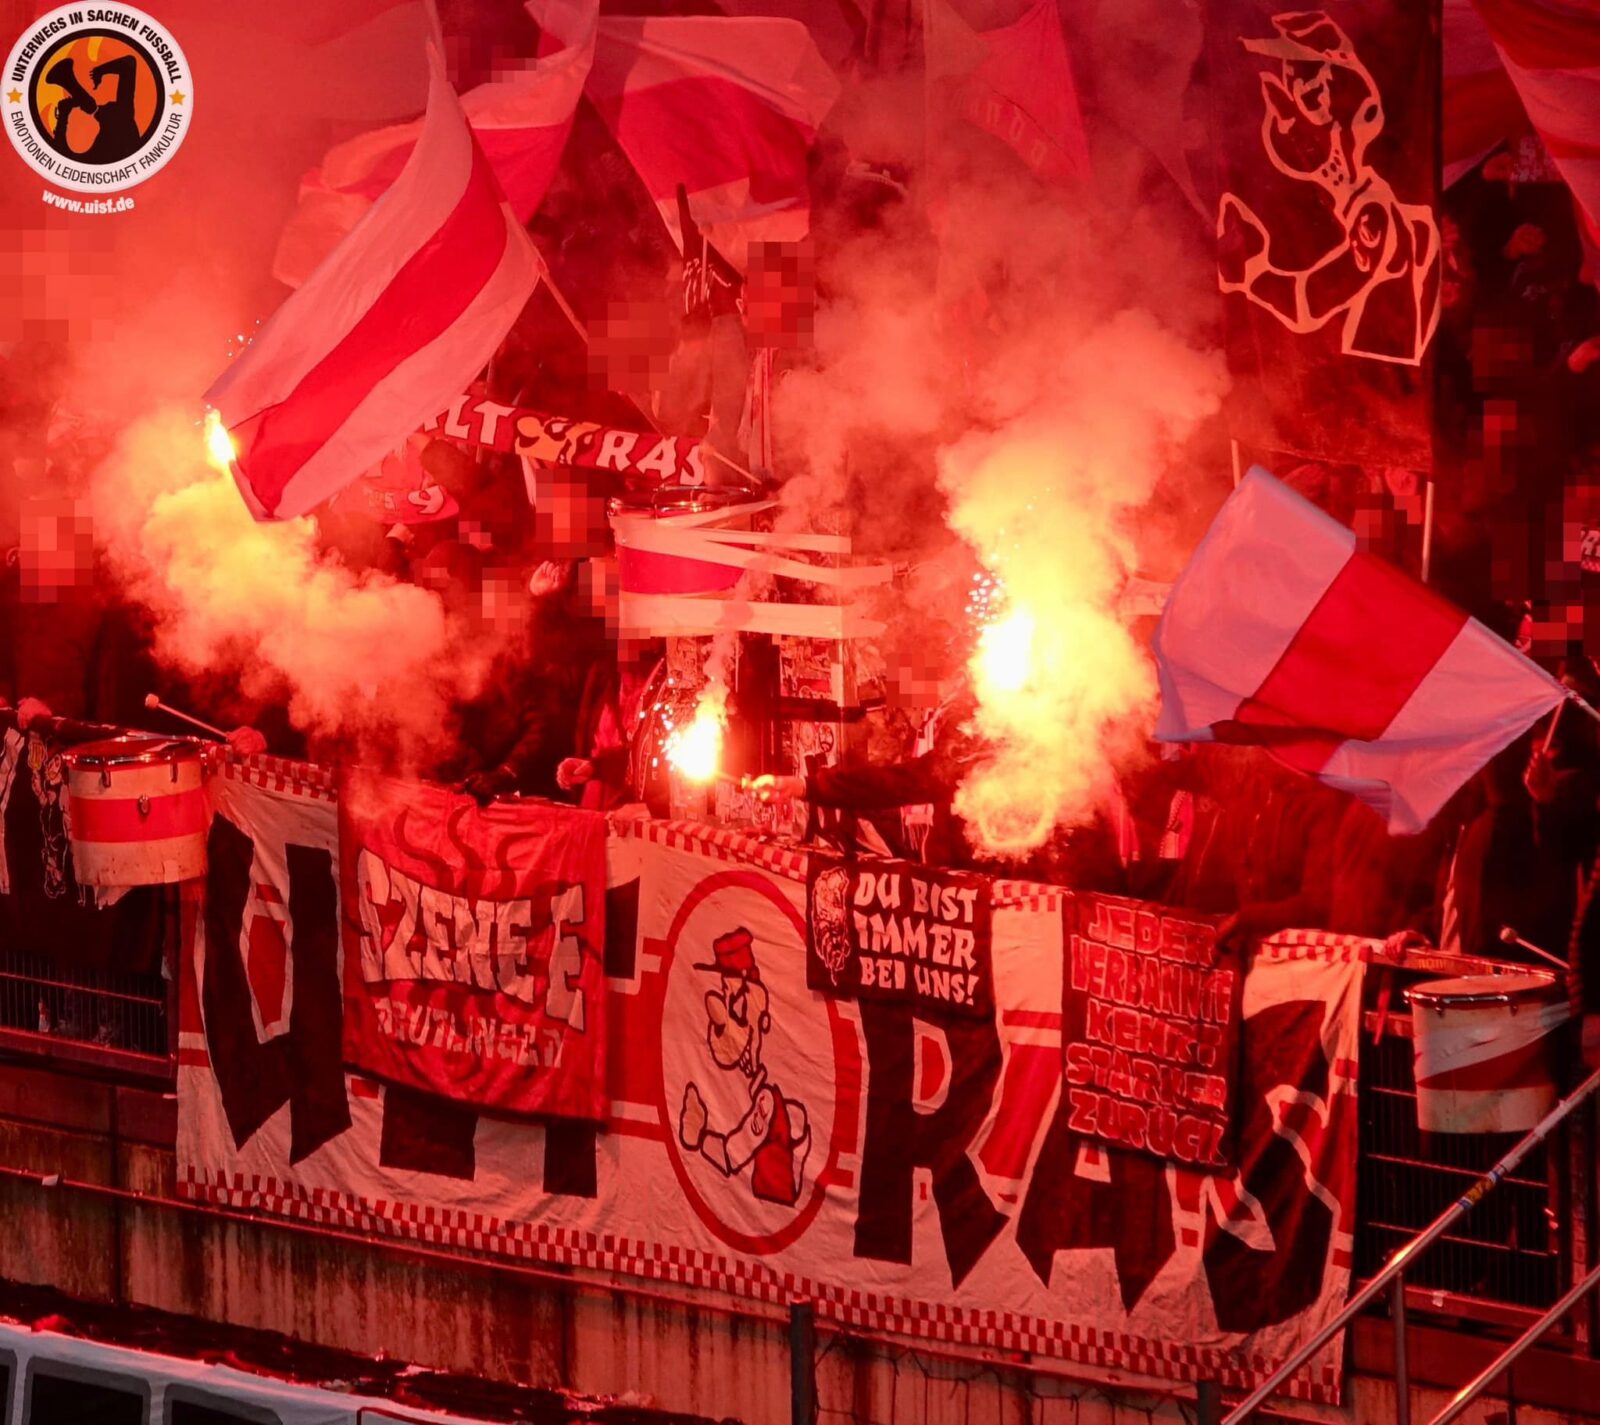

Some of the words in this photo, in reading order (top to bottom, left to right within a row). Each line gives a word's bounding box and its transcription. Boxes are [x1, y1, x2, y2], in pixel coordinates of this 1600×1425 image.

[854, 872, 901, 909] DU
[911, 877, 979, 923] BIST
[358, 848, 534, 1004] SZENE
[546, 885, 584, 1031] E
[853, 910, 977, 971] IMMER
[1088, 902, 1216, 966] JEDER
[859, 956, 906, 989] BEI
[913, 964, 980, 1006] UNS!
